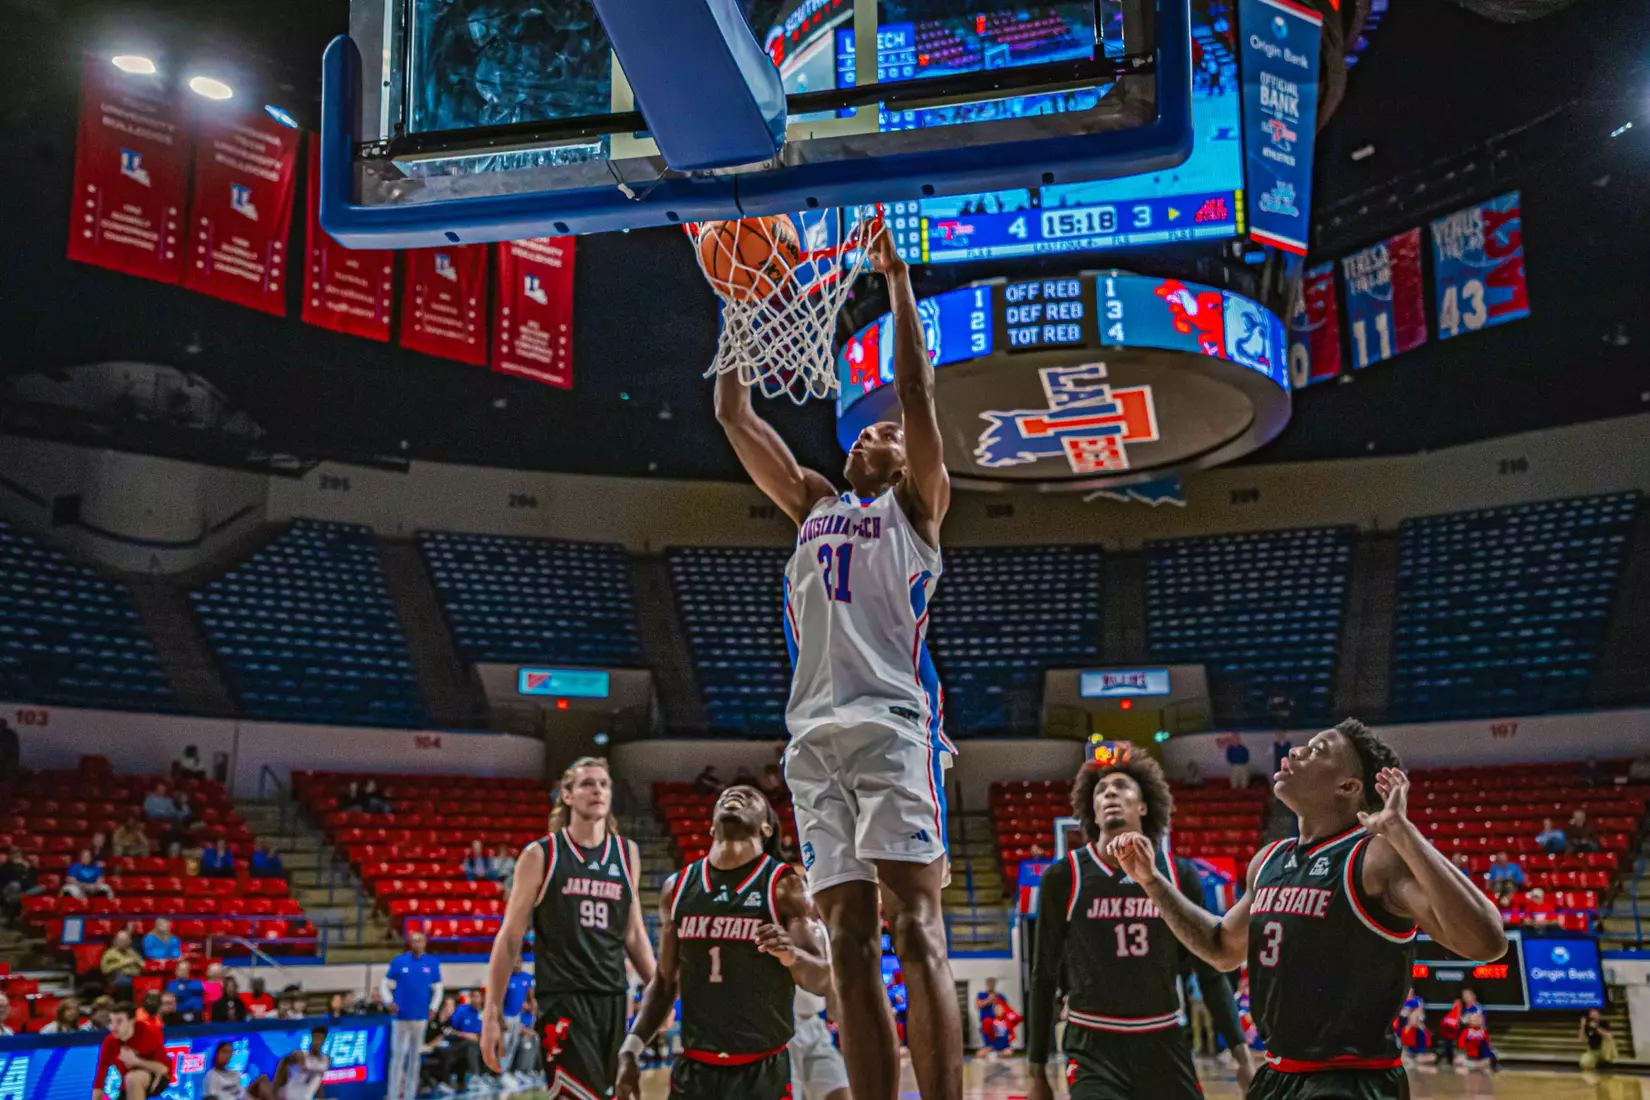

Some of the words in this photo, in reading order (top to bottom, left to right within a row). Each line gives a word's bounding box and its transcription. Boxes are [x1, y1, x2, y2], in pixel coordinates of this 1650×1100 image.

[1250, 34, 1282, 58] Origin
[1282, 46, 1309, 69] Bank
[1260, 84, 1299, 117] BANK
[1008, 215, 1028, 239] 4
[1045, 208, 1113, 236] 15:18
[1131, 205, 1151, 227] 3
[974, 289, 984, 308] 1
[1005, 282, 1041, 303] OFF
[1043, 280, 1081, 300] REB
[1103, 277, 1115, 298] 1
[1440, 279, 1487, 336] 43
[970, 310, 986, 331] 2
[1006, 303, 1043, 325] DEF
[1045, 301, 1084, 321] REB
[1105, 299, 1124, 320] 3
[971, 332, 986, 354] 3
[1007, 326, 1041, 347] TOT
[1042, 323, 1081, 343] REB
[1106, 322, 1125, 342] 4
[1352, 313, 1391, 368] 11
[853, 516, 881, 539] ECH
[818, 542, 852, 604] 21
[16, 709, 48, 726] 103
[561, 877, 590, 895] JAX
[590, 880, 622, 901] STATE
[1273, 887, 1332, 918] STATE
[580, 899, 609, 930] 99
[1086, 897, 1122, 919] JAX
[1123, 897, 1160, 918] STA
[677, 916, 711, 939] JAX
[1114, 922, 1149, 957] 13
[1259, 920, 1283, 968] 3
[708, 945, 723, 983] 1
[1531, 967, 1564, 983] Origin
[1568, 967, 1596, 981] Bank
